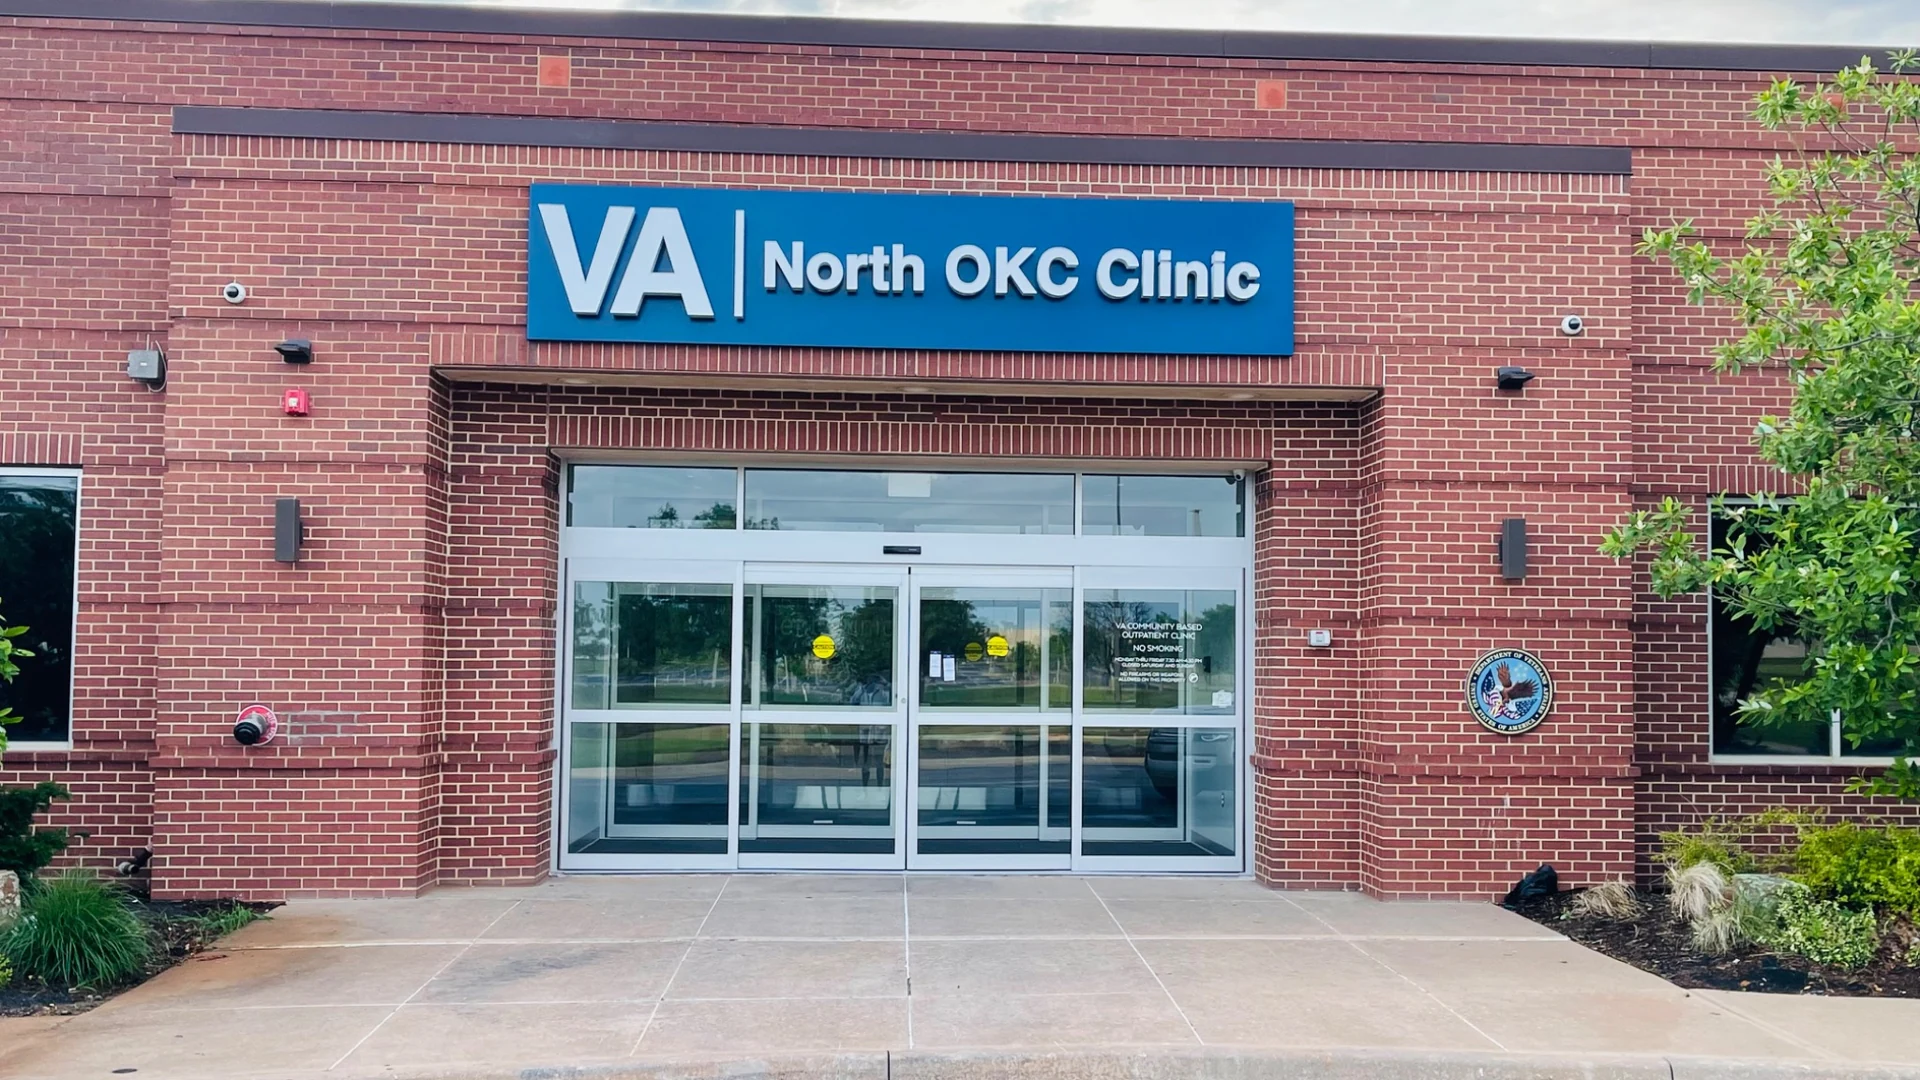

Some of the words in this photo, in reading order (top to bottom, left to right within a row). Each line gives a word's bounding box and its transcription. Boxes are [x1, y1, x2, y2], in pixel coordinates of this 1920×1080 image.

[537, 203, 714, 319] VA
[763, 239, 926, 294] North
[944, 242, 1080, 300] OKC
[1096, 247, 1262, 304] Clinic
[1122, 631, 1169, 639] OUTPATIENT
[1170, 632, 1196, 640] CLINIC
[1127, 622, 1175, 630] COMMUNITY
[1176, 623, 1203, 631] BASED
[1475, 651, 1512, 675] DEPARTMENT
[1524, 655, 1548, 685] VETERANS
[1470, 682, 1480, 709] UNITED
[1476, 709, 1497, 727] STATES
[1508, 718, 1537, 731] AMERICA
